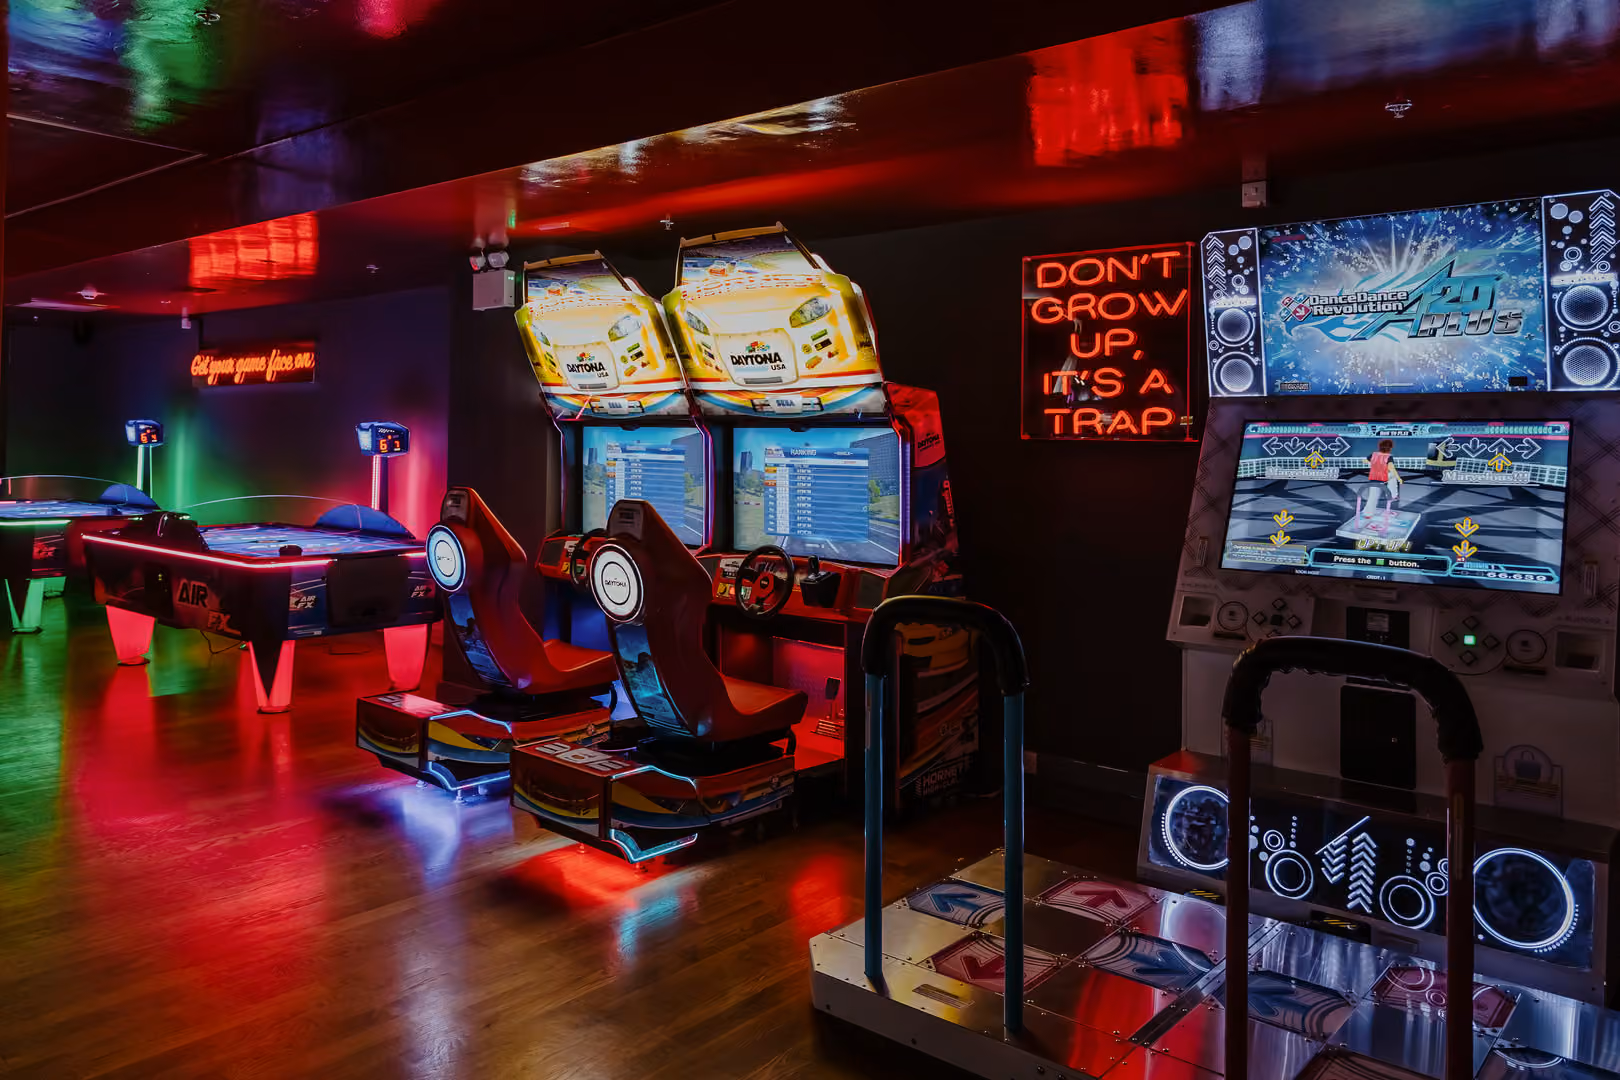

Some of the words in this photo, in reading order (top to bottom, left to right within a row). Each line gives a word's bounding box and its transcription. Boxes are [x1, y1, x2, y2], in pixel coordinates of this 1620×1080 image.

[1037, 251, 1181, 288] DON'T
[1031, 288, 1188, 324] GROW
[1309, 290, 1409, 307] DanceDance
[1312, 300, 1405, 316] Revolution
[1414, 308, 1525, 338] PLUS
[1070, 328, 1145, 361] UP,
[190, 354, 209, 376] Get
[207, 356, 235, 385] your
[234, 356, 267, 384] game
[266, 348, 294, 382] face
[294, 352, 315, 369] on
[566, 361, 606, 374] DAYTONA
[730, 352, 783, 366] DAYTONA
[770, 363, 787, 371] USA
[1043, 367, 1126, 398] IT'S
[1138, 368, 1175, 394] A
[1043, 406, 1176, 435] TRAP
[379, 439, 388, 451] 6
[1333, 555, 1356, 564] Press
[1357, 557, 1372, 565] the
[1388, 559, 1420, 568] button.
[177, 578, 209, 608] AIR
[207, 610, 241, 636] FX
